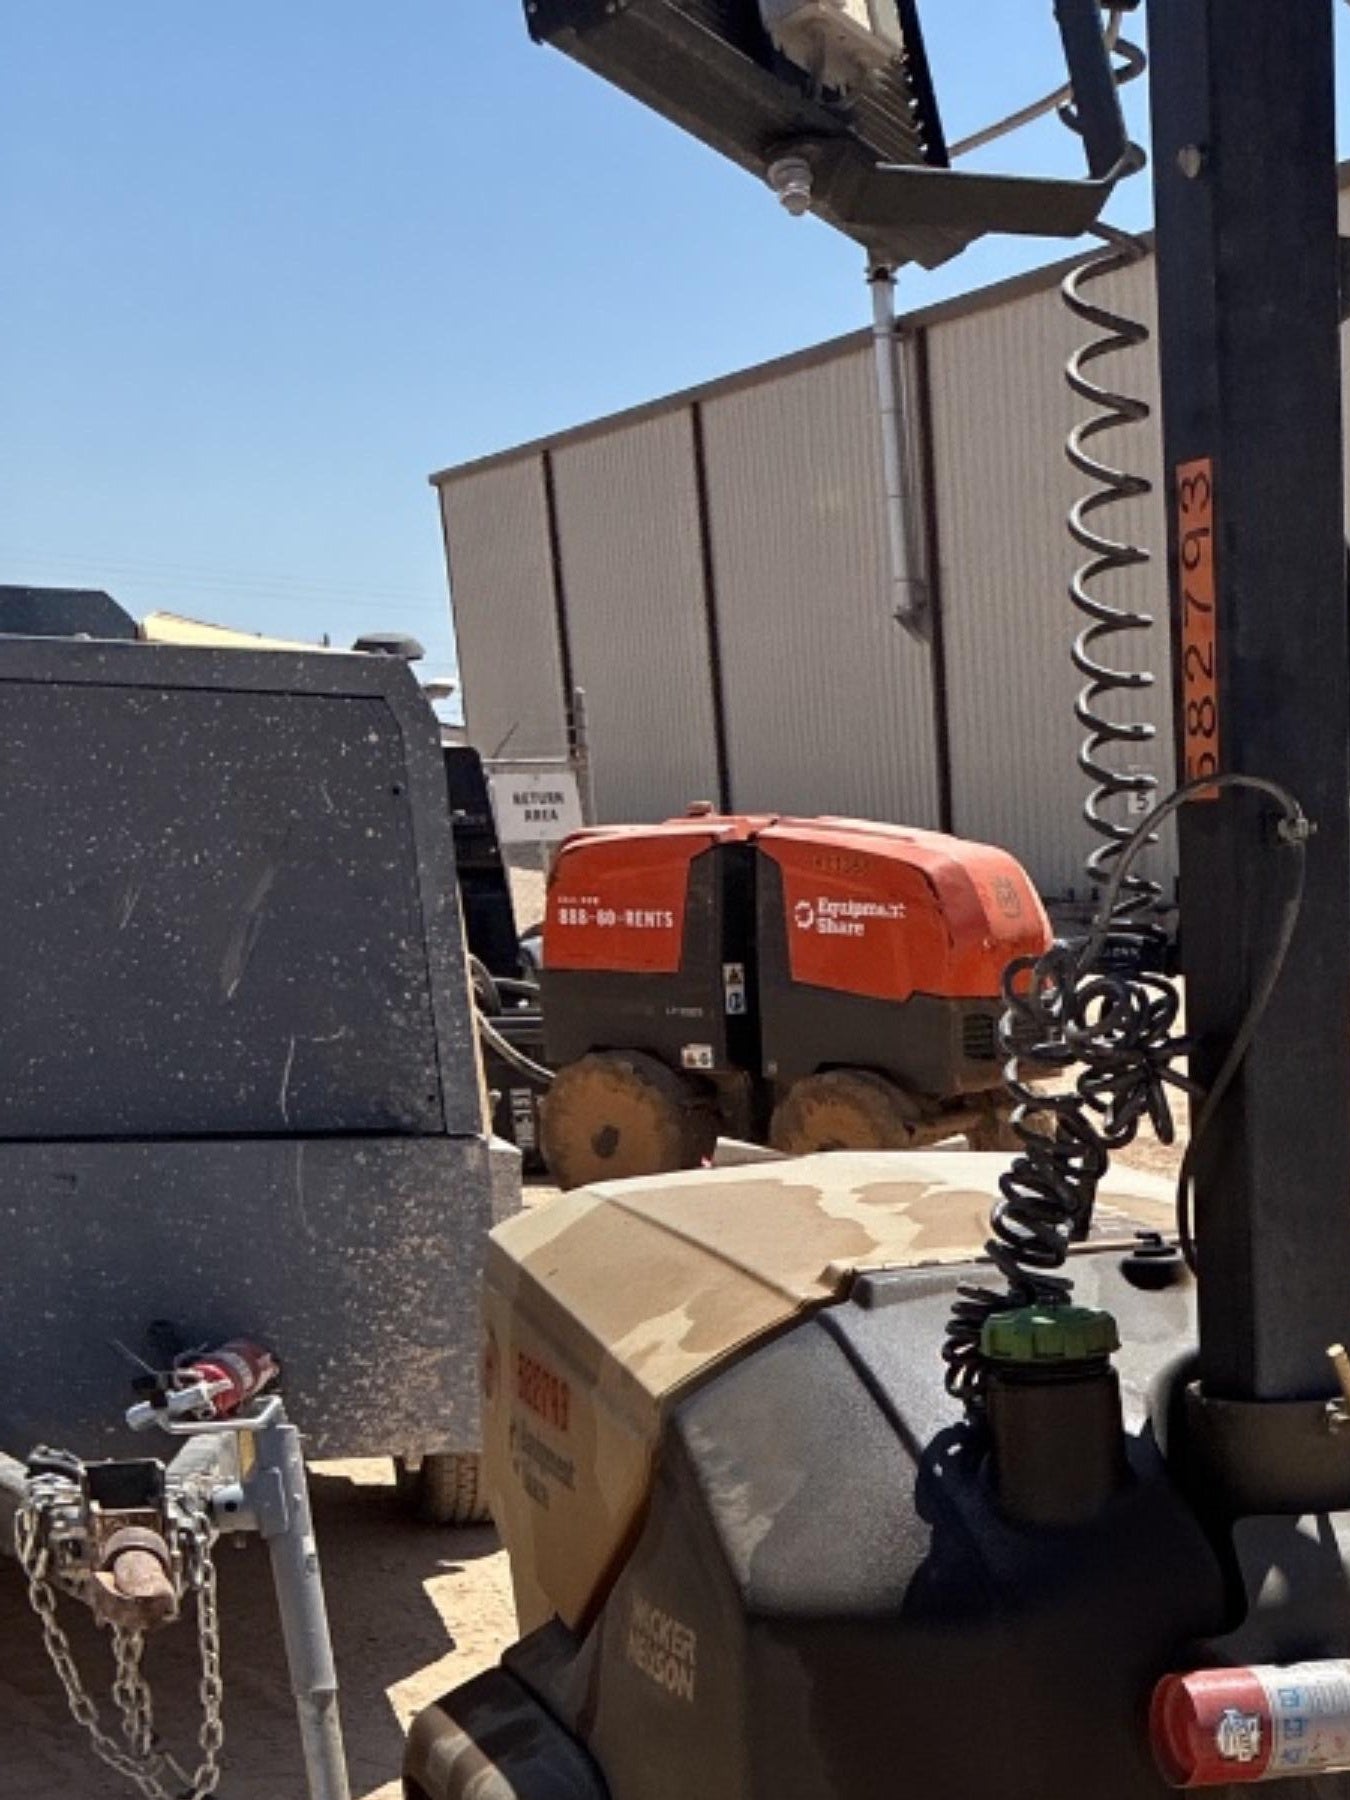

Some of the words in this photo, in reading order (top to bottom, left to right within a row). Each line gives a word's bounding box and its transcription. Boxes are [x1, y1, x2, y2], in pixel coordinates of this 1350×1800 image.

[1181, 471, 1216, 788] 582793
[512, 791, 564, 805] RETURN
[524, 808, 559, 822] AREA
[817, 918, 865, 937] Share
